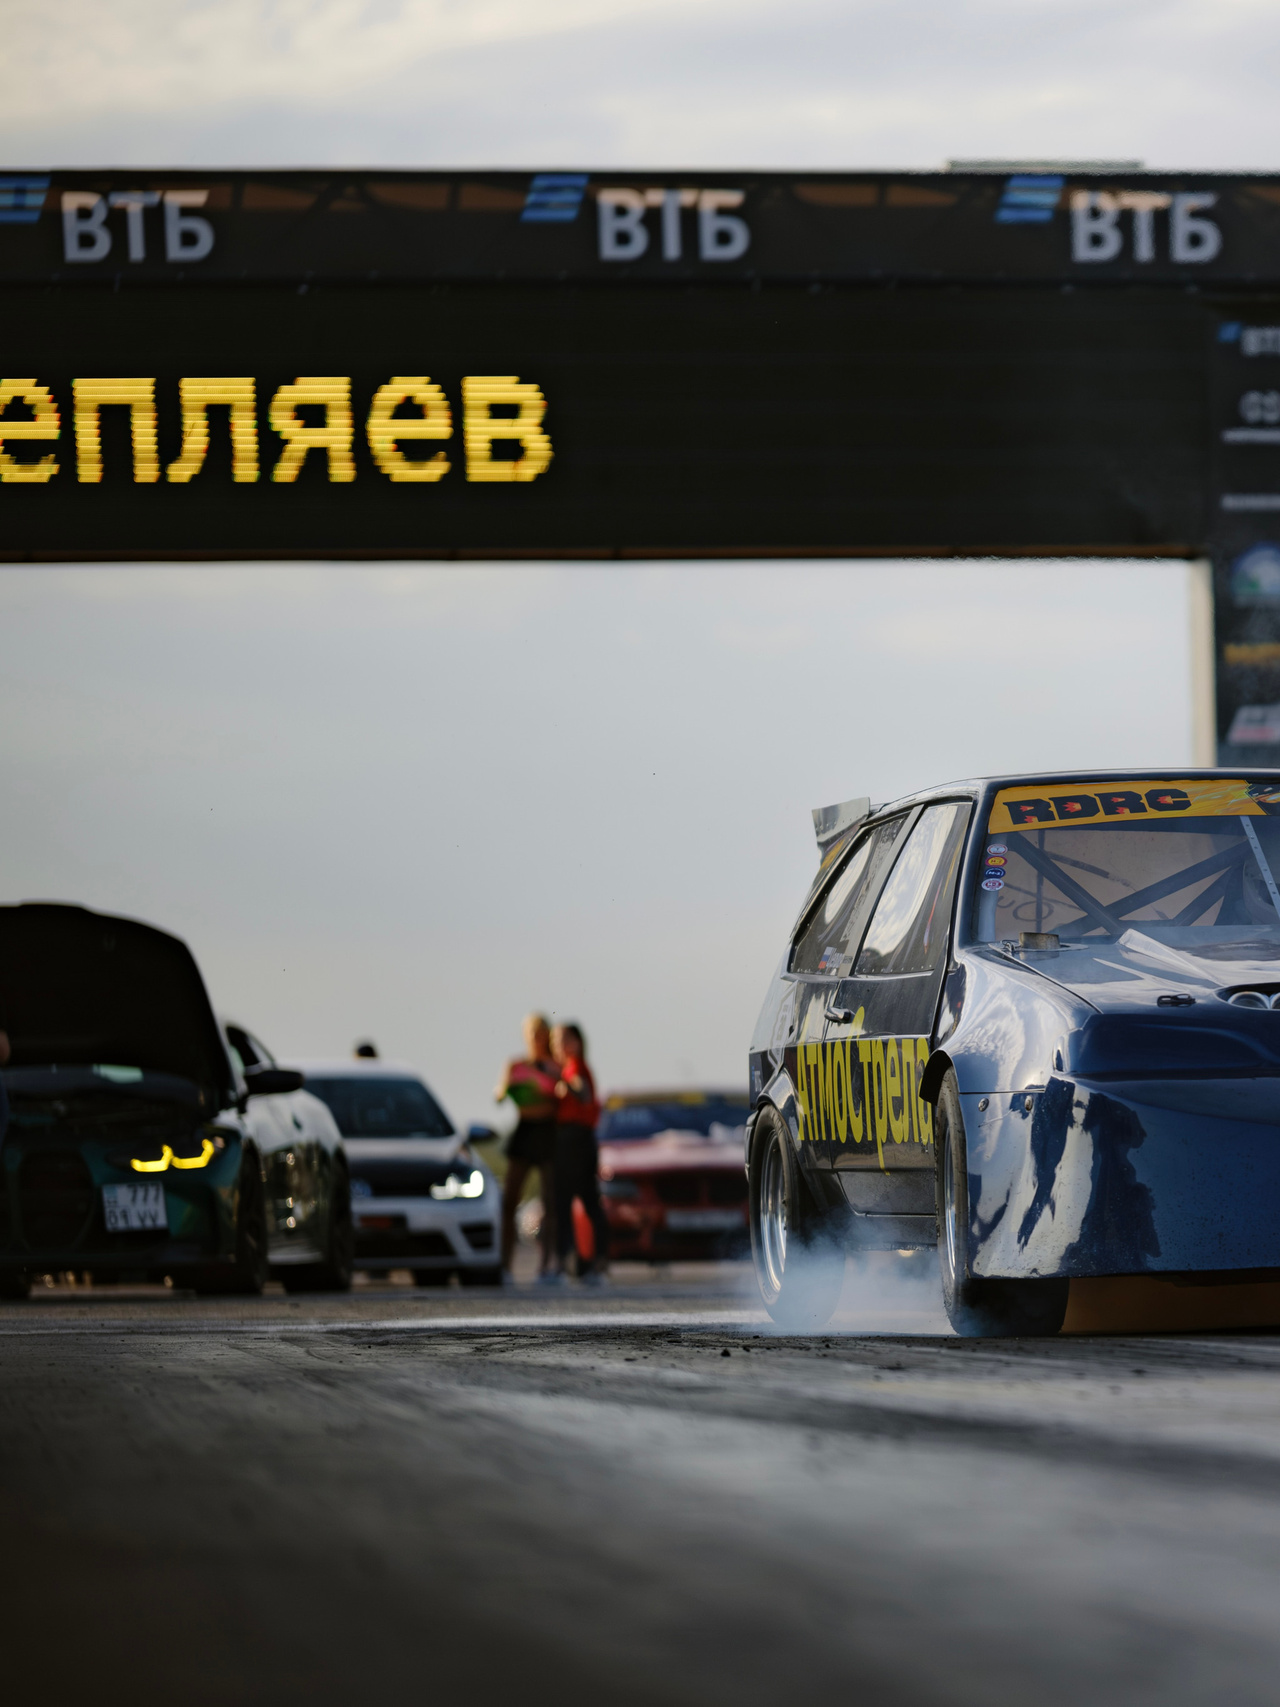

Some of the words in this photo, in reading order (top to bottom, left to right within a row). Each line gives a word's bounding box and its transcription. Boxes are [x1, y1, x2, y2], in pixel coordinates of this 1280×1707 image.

[60, 190, 216, 264] ВТБ
[597, 188, 751, 262] ВТБ
[1069, 190, 1223, 264] ВТБ
[0, 376, 555, 483] епляев
[1002, 788, 1193, 824] RDRC
